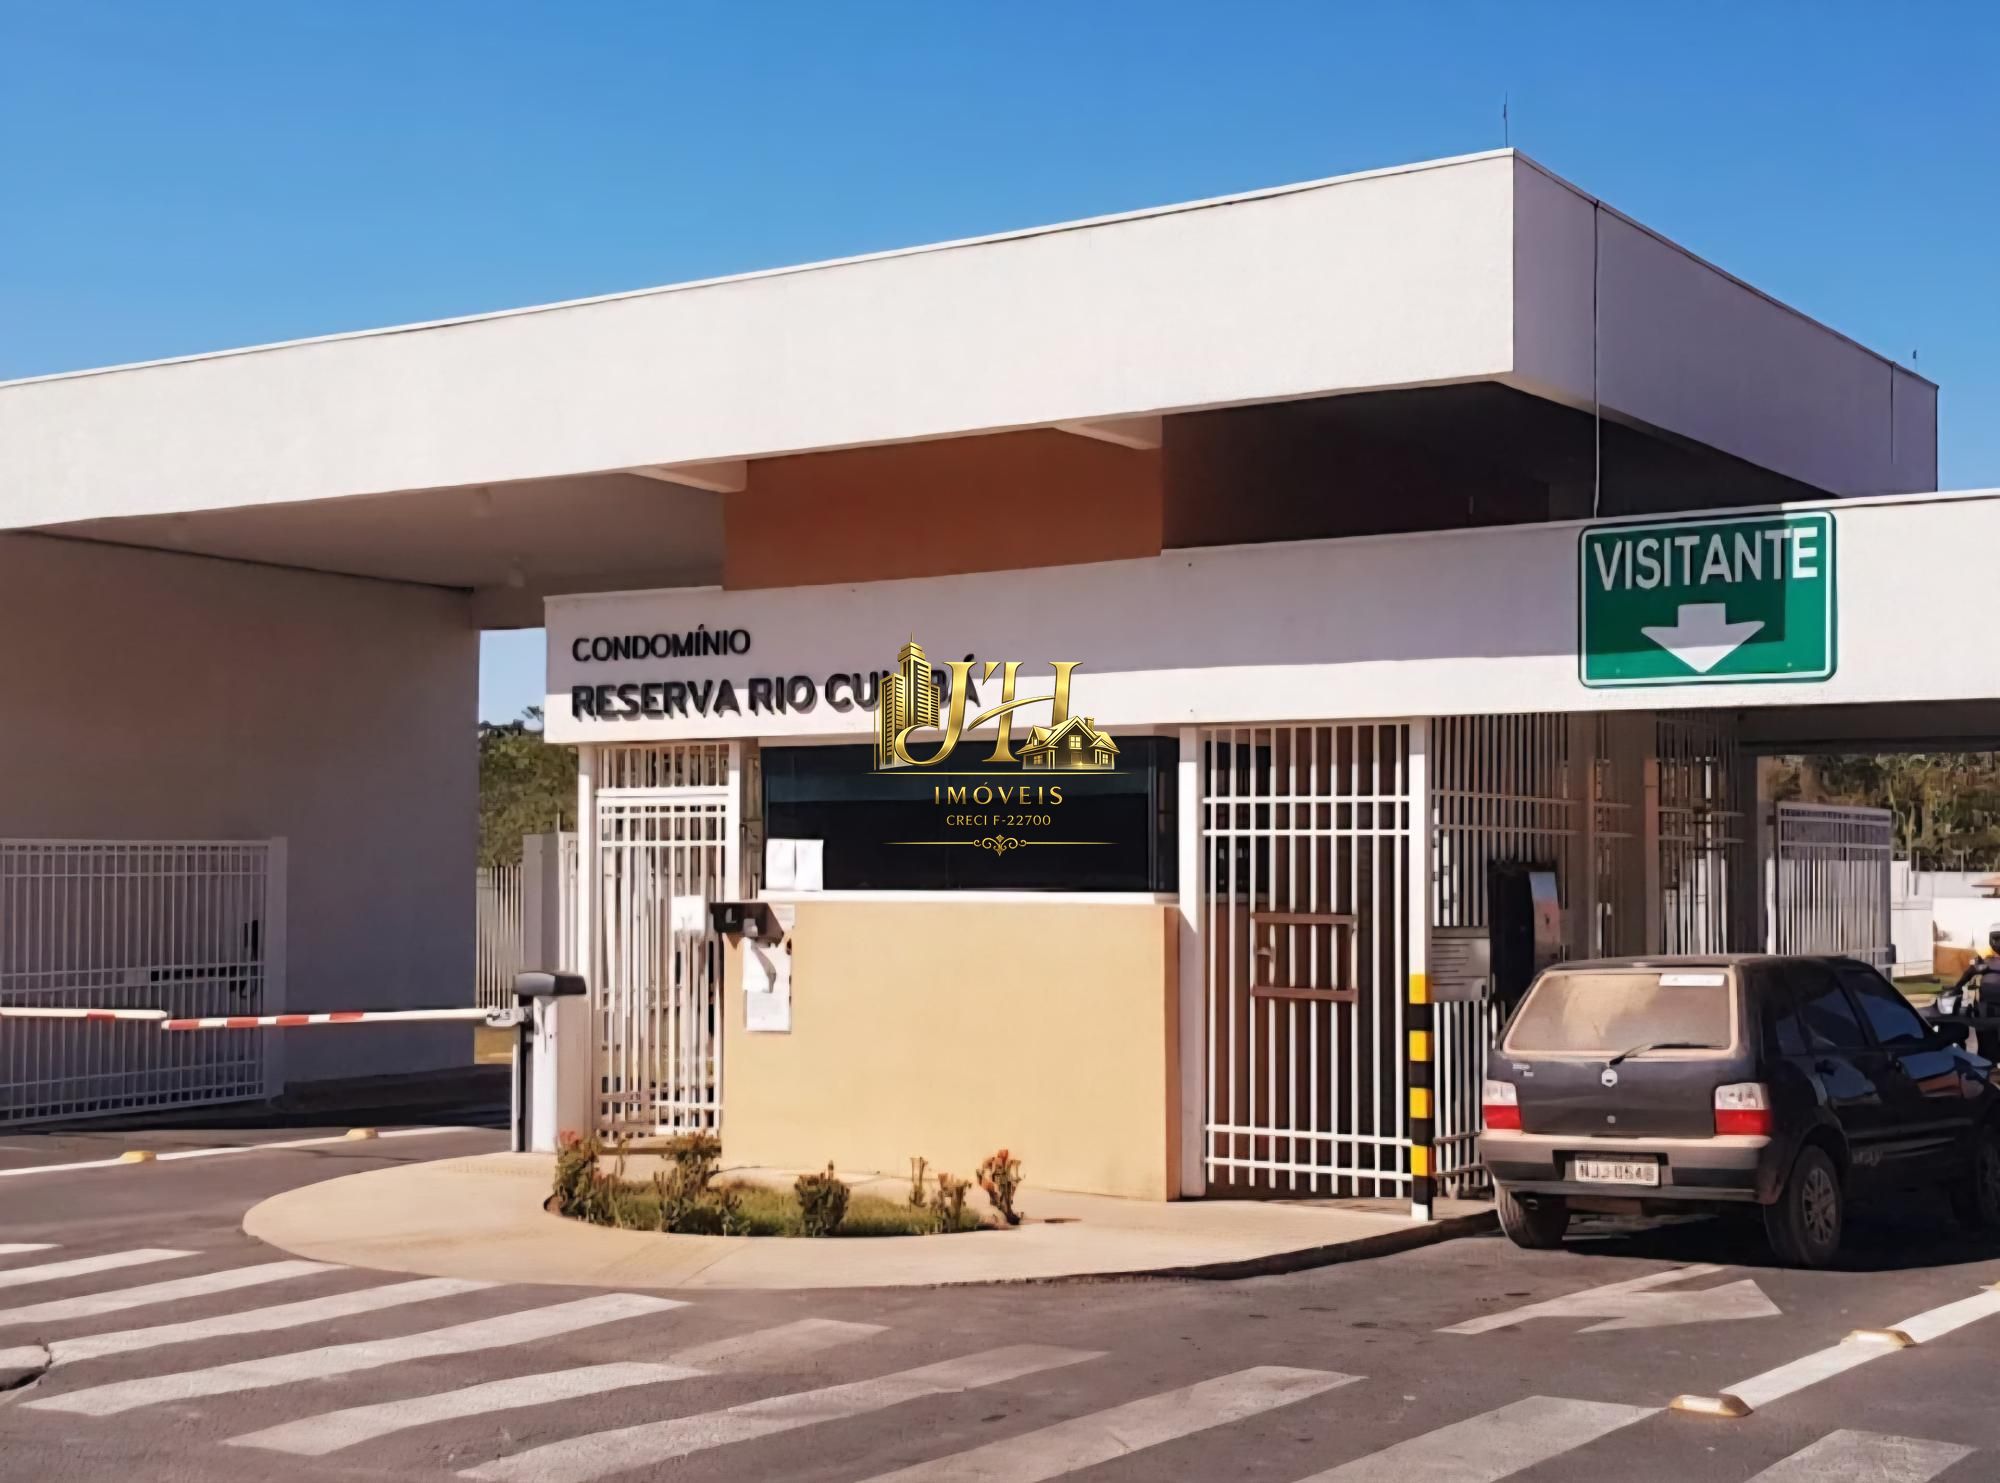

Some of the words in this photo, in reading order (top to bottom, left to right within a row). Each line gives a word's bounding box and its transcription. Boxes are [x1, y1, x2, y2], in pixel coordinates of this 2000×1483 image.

[1593, 526, 1819, 592] VISITANTE
[572, 624, 751, 662] CONDOMÍNIO
[572, 678, 741, 721] RESERVA
[748, 675, 817, 716] RIO
